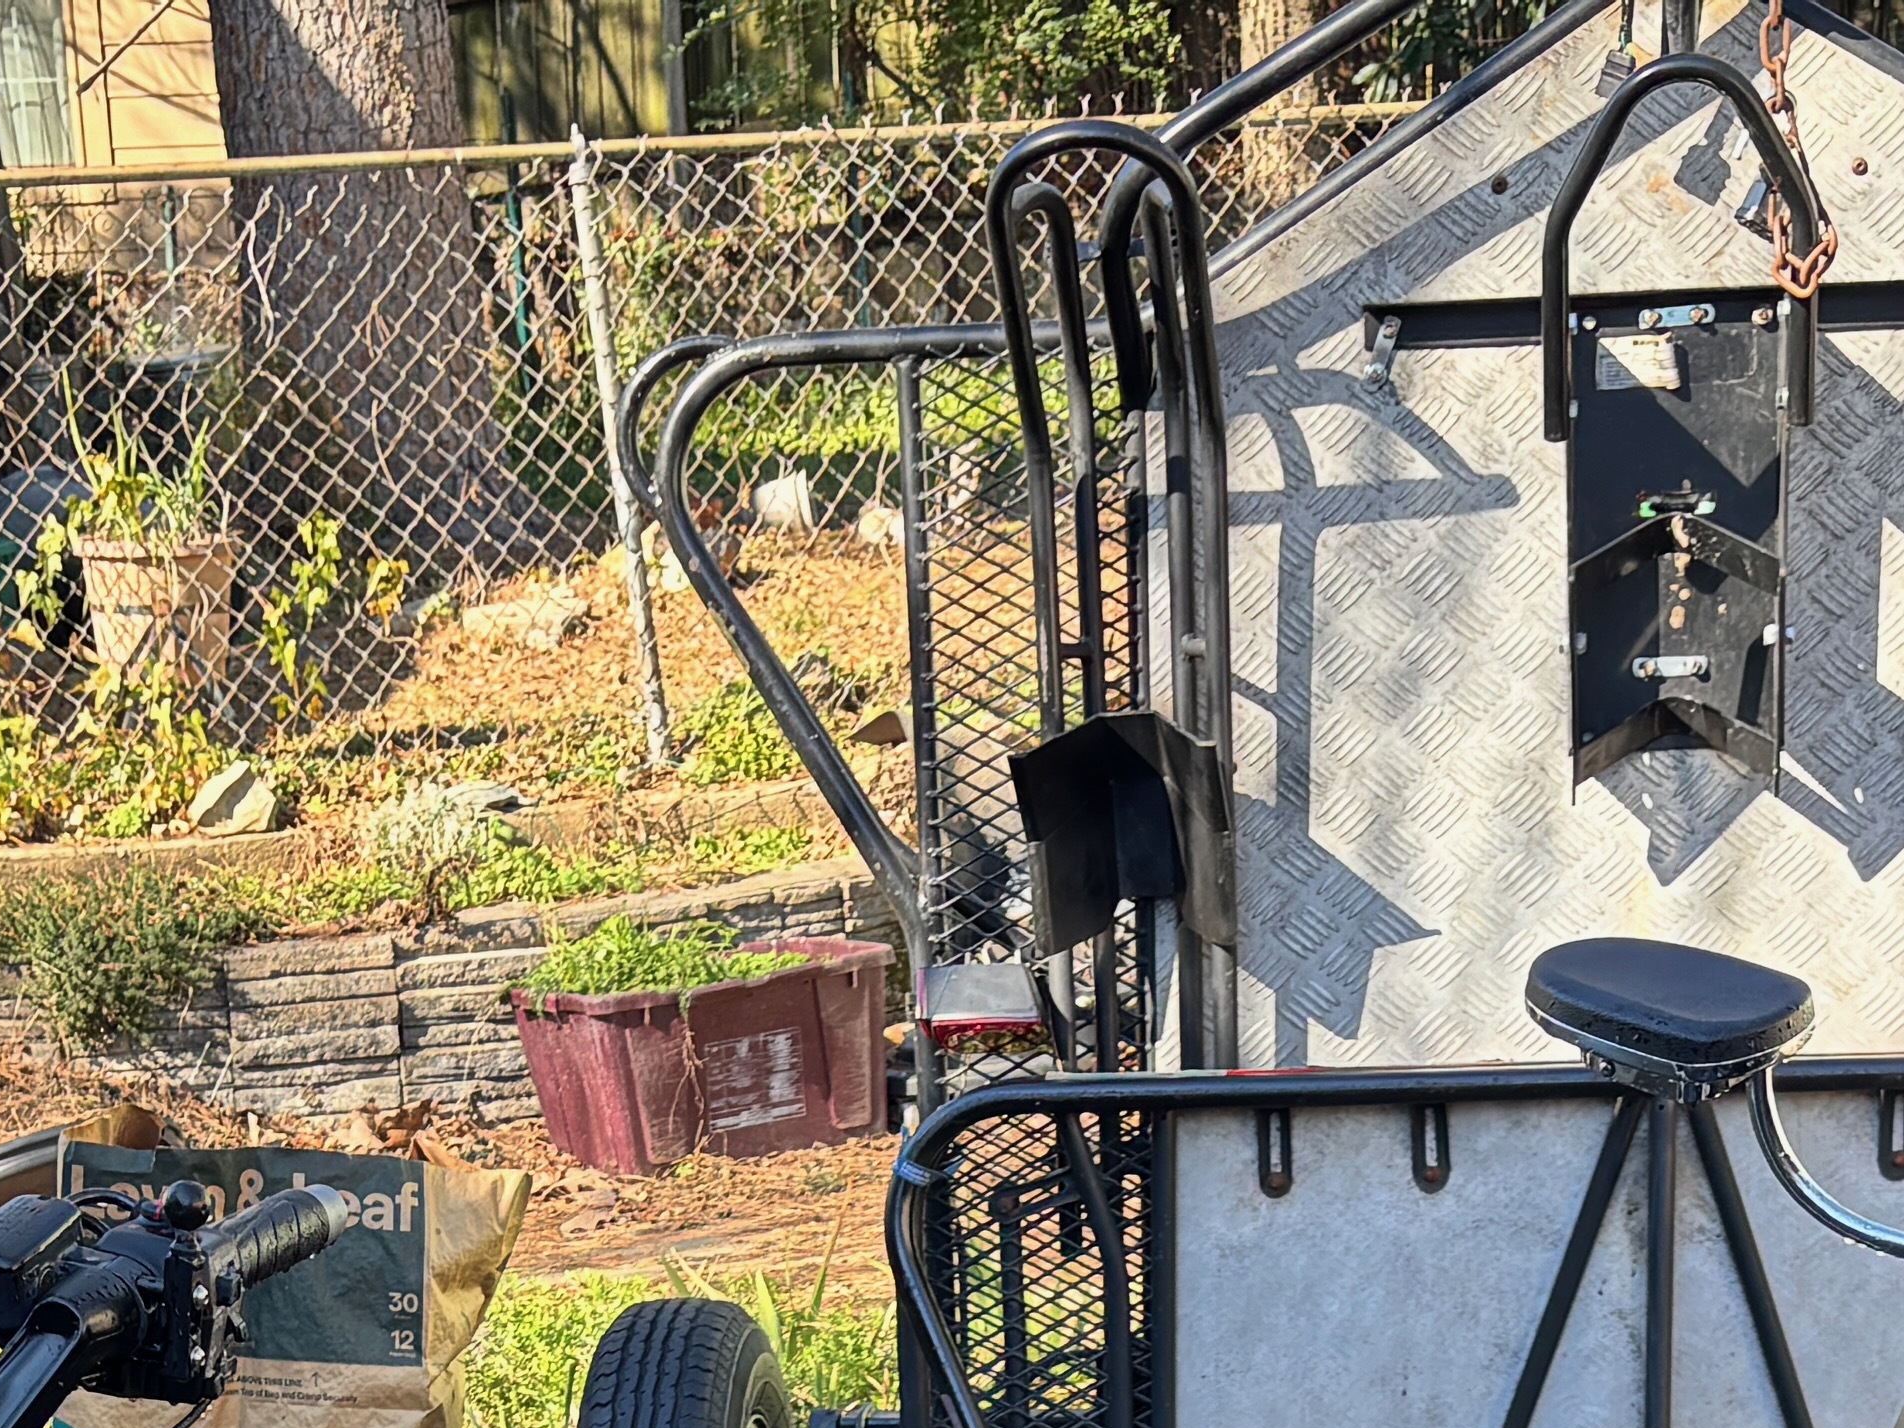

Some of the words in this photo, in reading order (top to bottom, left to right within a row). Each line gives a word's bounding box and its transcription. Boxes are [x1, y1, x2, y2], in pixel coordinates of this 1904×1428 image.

[237, 1169, 264, 1214] &
[388, 1292, 419, 1313] 30
[390, 1330, 415, 1350] 12
[236, 1375, 263, 1385] ABOVE
[264, 1377, 283, 1386] THIS
[284, 1378, 303, 1387] LINE
[264, 1389, 280, 1400] Bag
[281, 1391, 296, 1400] and
[296, 1391, 322, 1402] Crimp
[322, 1392, 358, 1404] Securely
